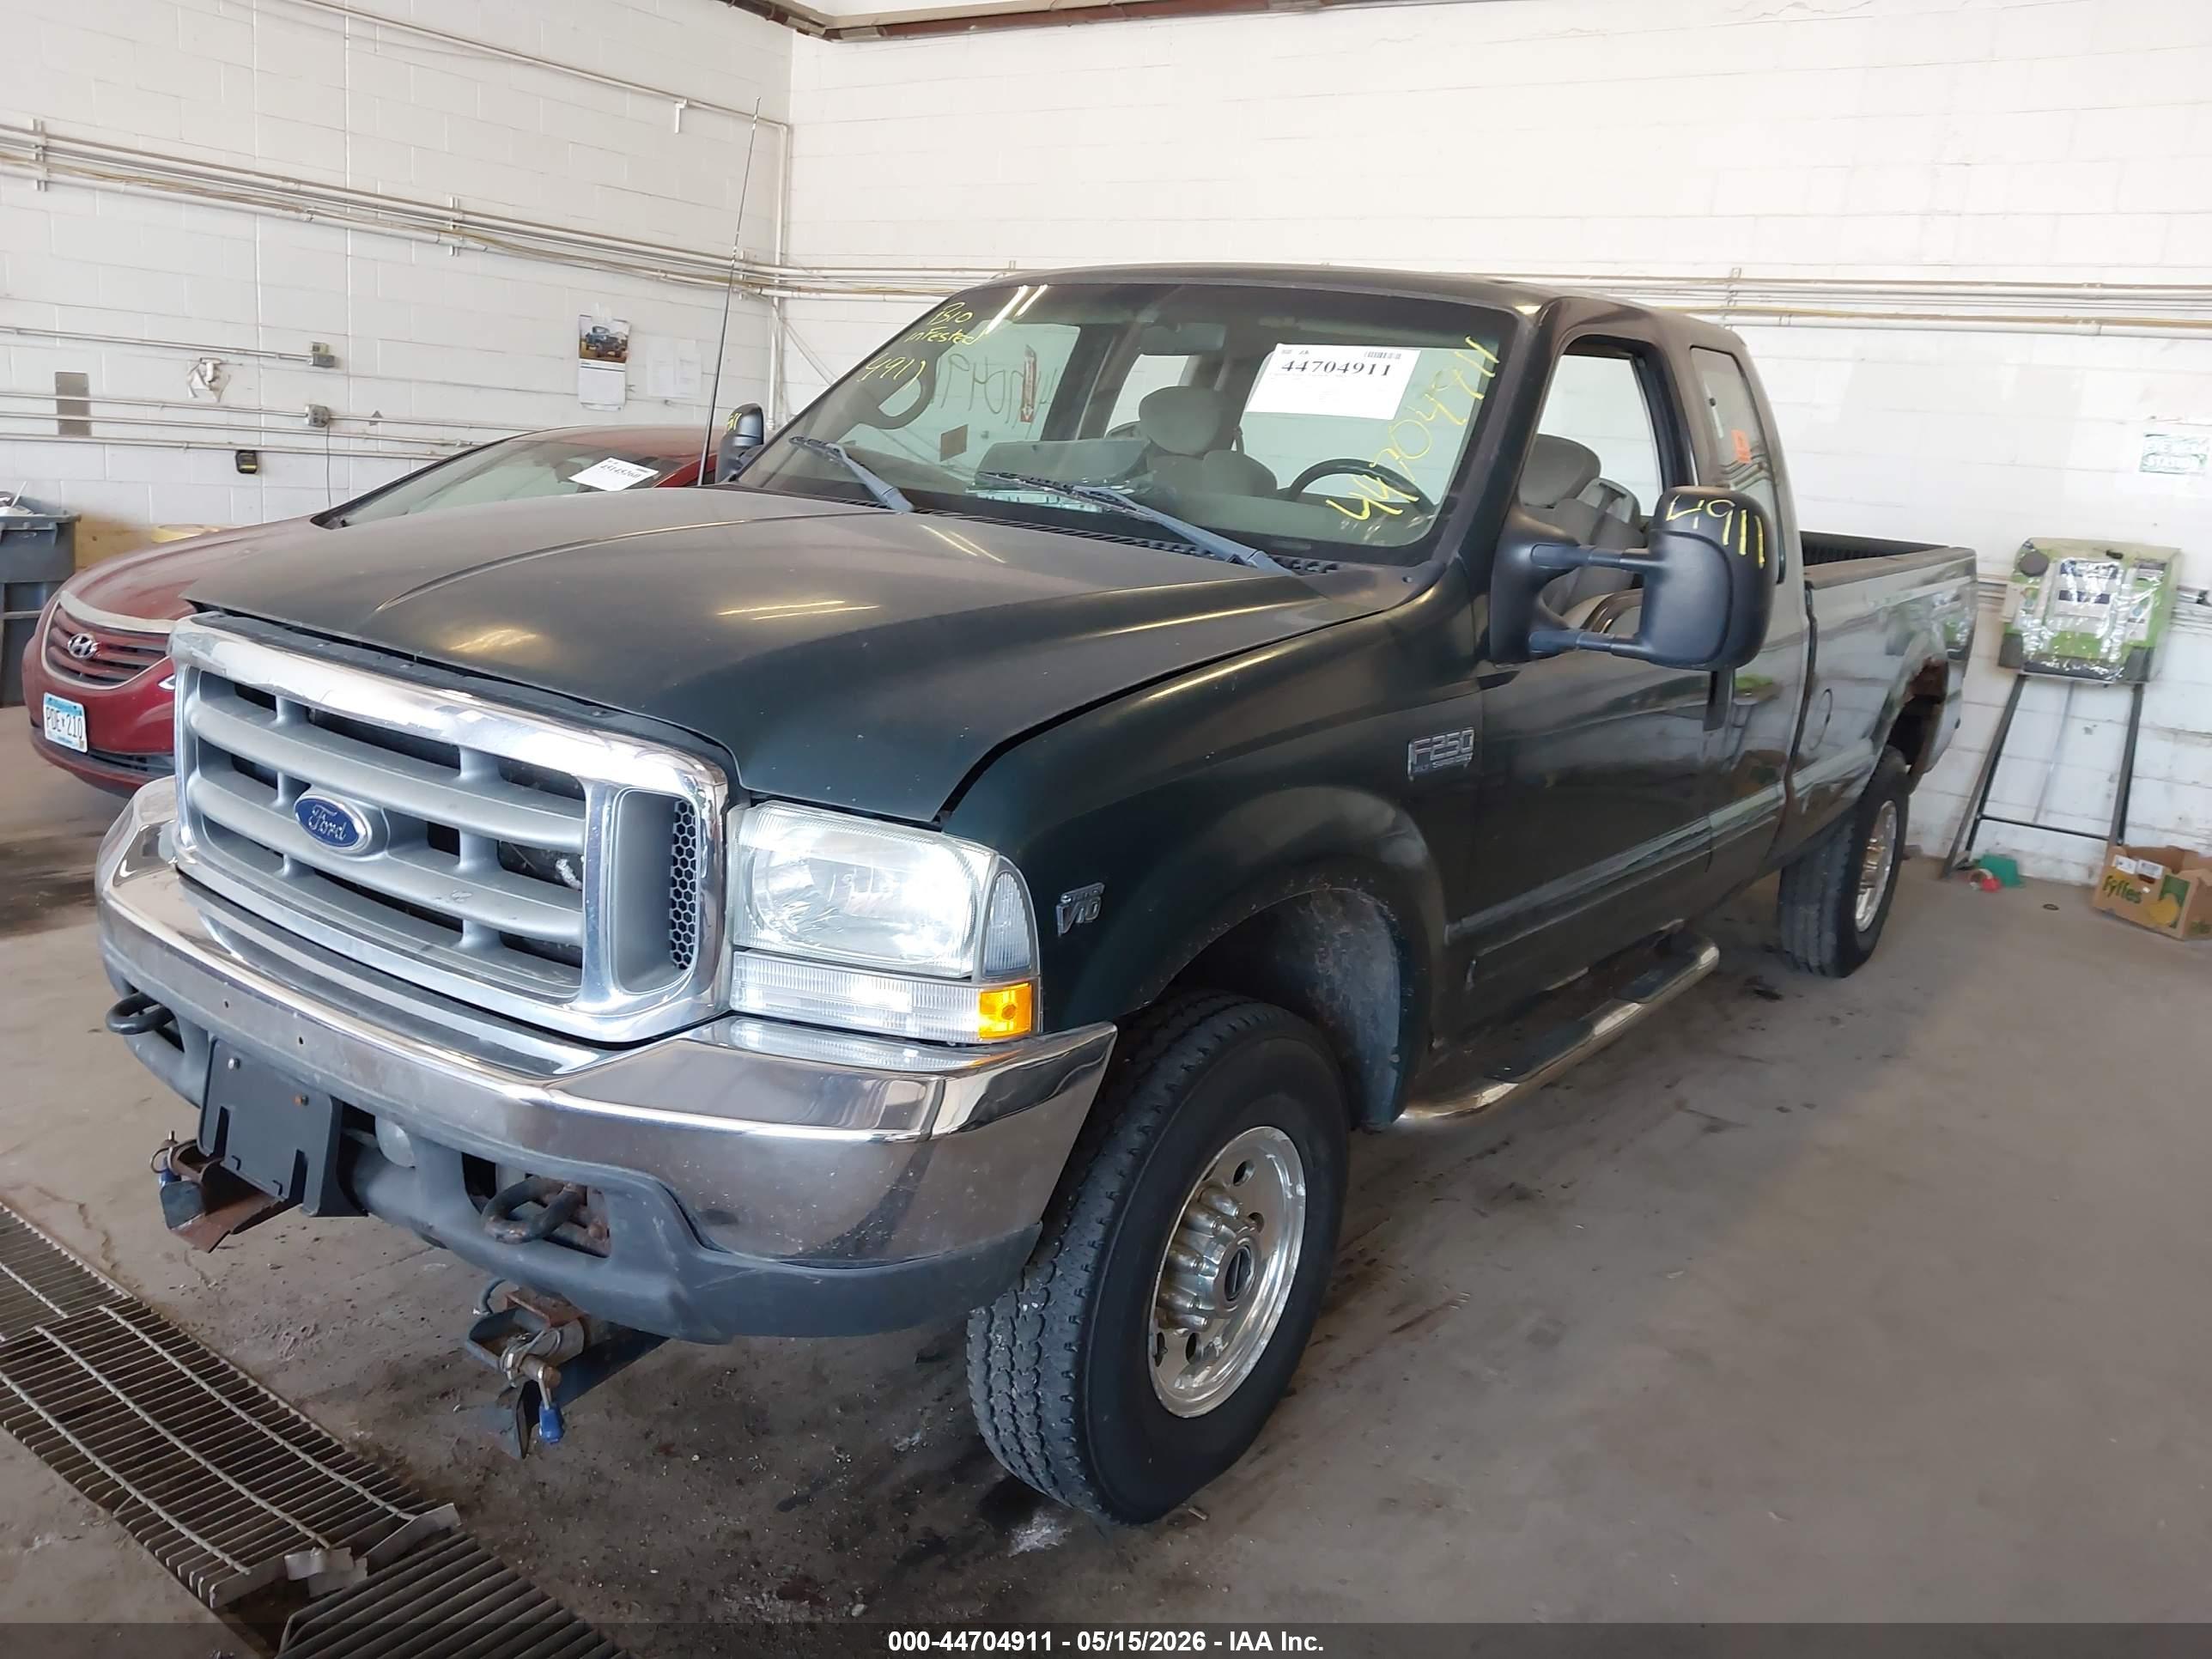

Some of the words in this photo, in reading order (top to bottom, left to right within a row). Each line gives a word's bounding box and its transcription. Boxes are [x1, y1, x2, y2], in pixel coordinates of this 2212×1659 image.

[1281, 360, 1392, 376] 44704911
[1665, 495, 1765, 569] 4911
[308, 804, 347, 842] Ford
